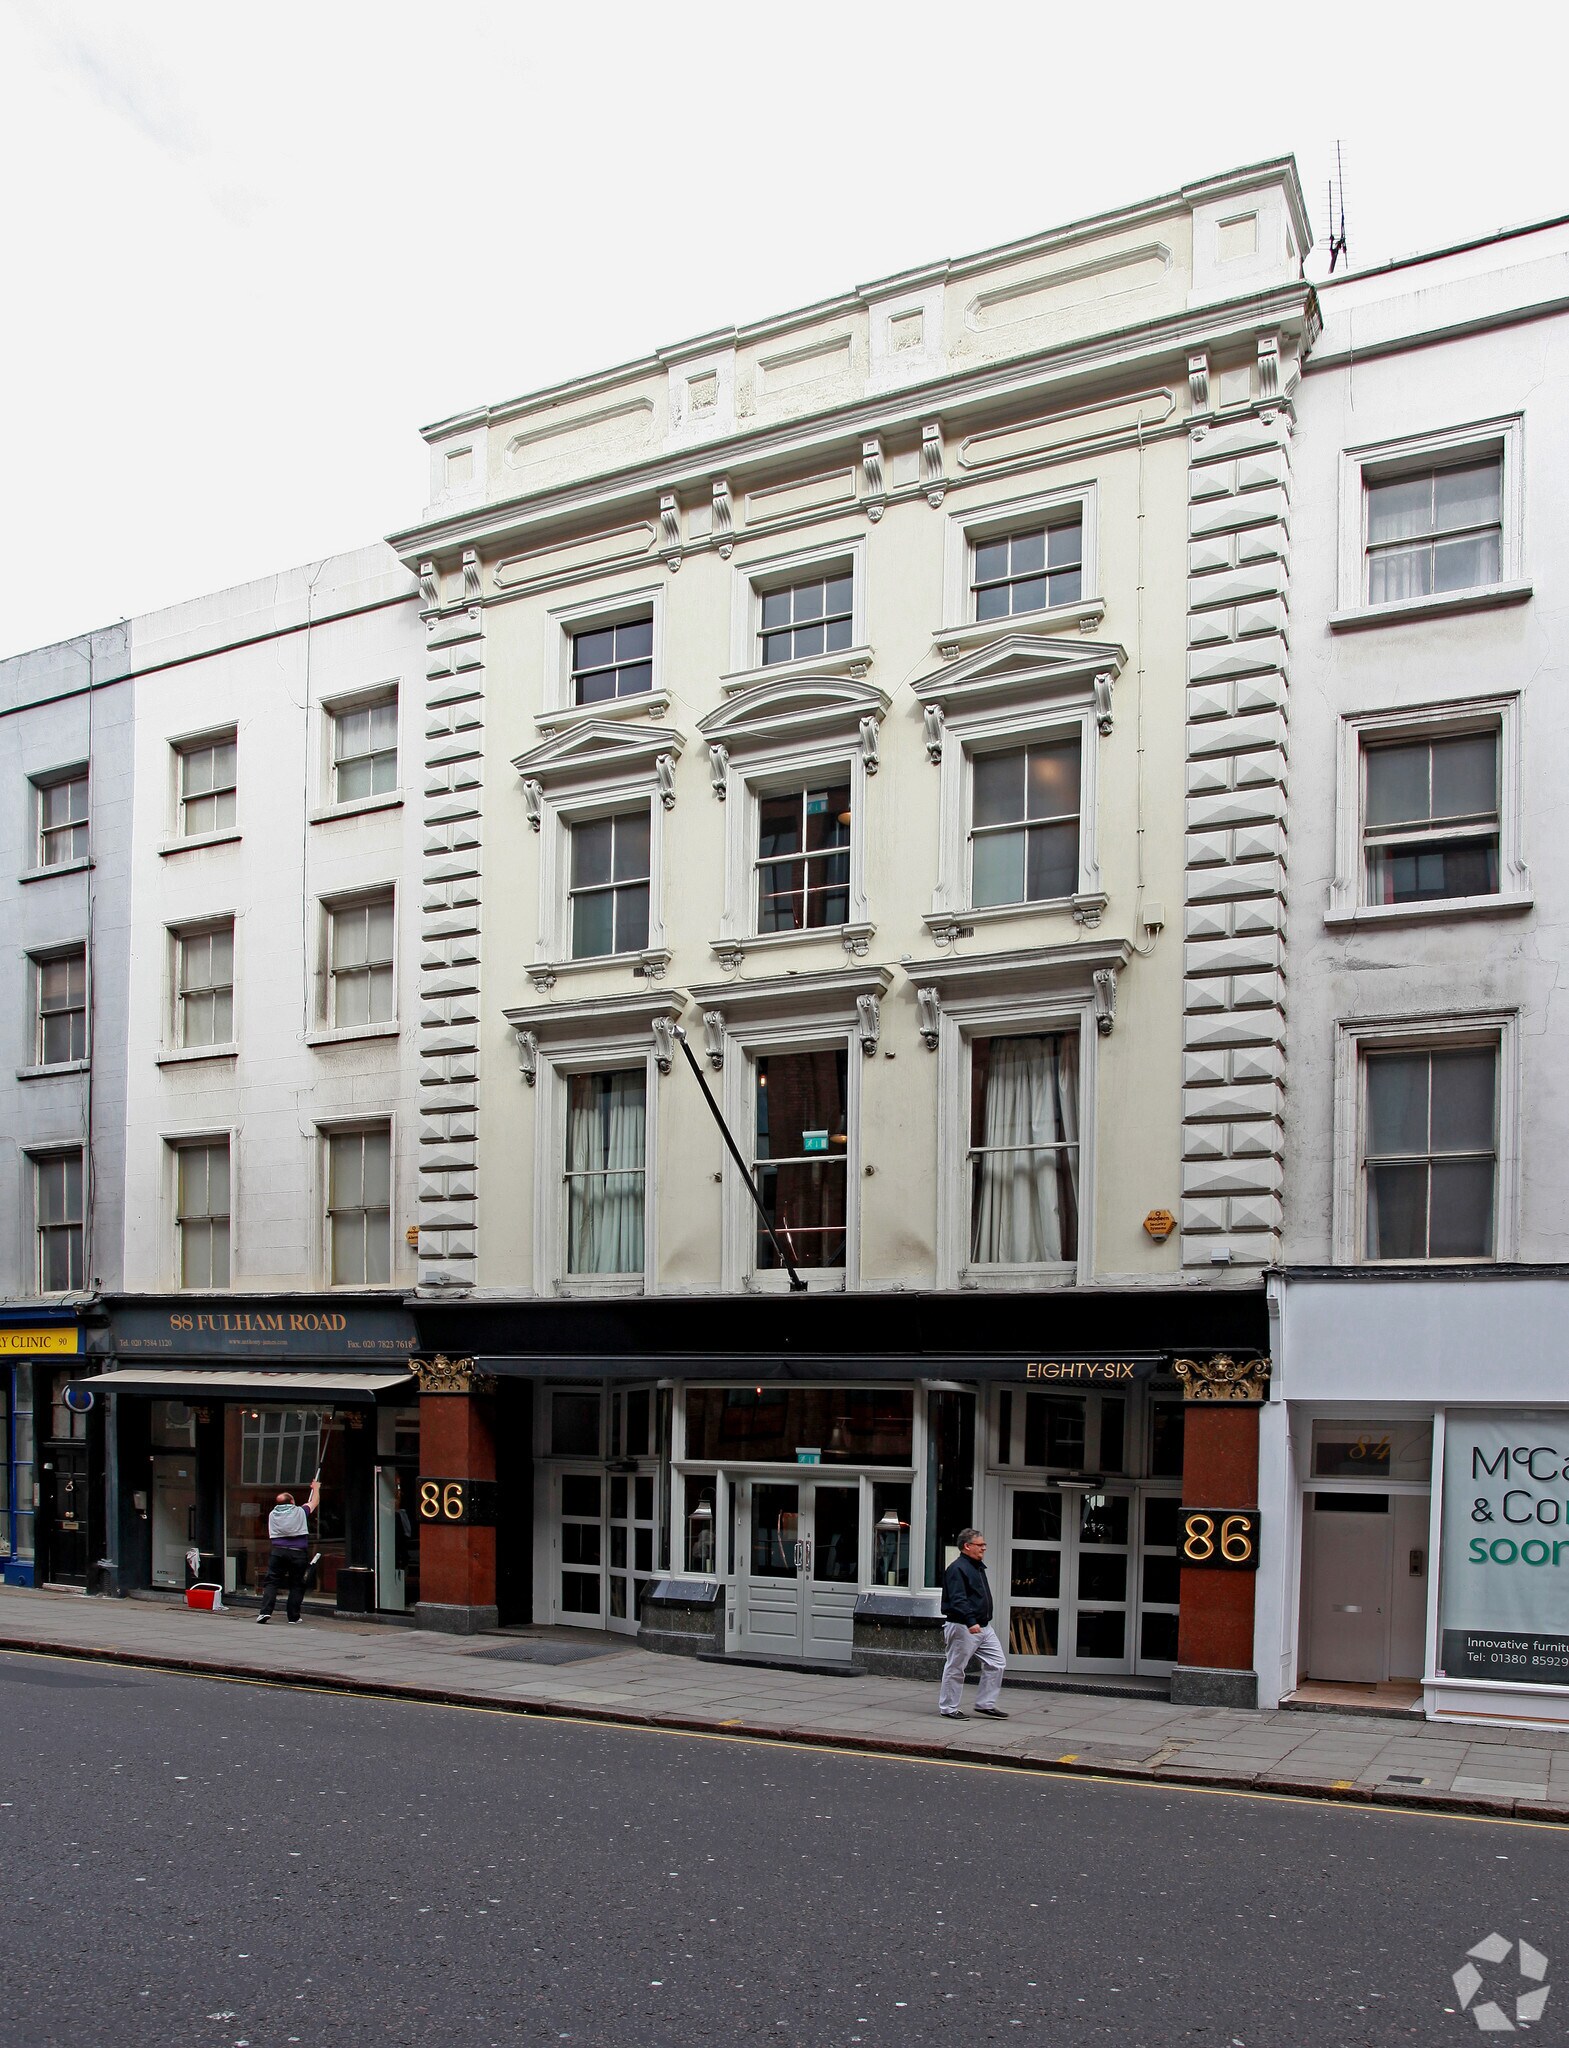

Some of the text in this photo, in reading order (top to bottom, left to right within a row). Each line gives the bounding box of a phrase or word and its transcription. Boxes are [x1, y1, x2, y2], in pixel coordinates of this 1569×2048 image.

[170, 1314, 347, 1331] 88 FULHAM ROAD
[11, 1335, 52, 1348] CLINIC
[58, 1337, 67, 1345] 90
[363, 1340, 375, 1348] 020
[378, 1340, 394, 1348] 7823
[396, 1340, 412, 1348] 7618
[1026, 1363, 1135, 1378] EIGHTY-SIX
[1349, 1433, 1392, 1462] 84
[421, 1481, 463, 1519] 86
[1471, 1490, 1569, 1524] & Co
[1184, 1514, 1252, 1562] 86
[1467, 1637, 1529, 1650] Innovative
[1467, 1652, 1486, 1662] Tel:
[1491, 1653, 1527, 1665] 01380
